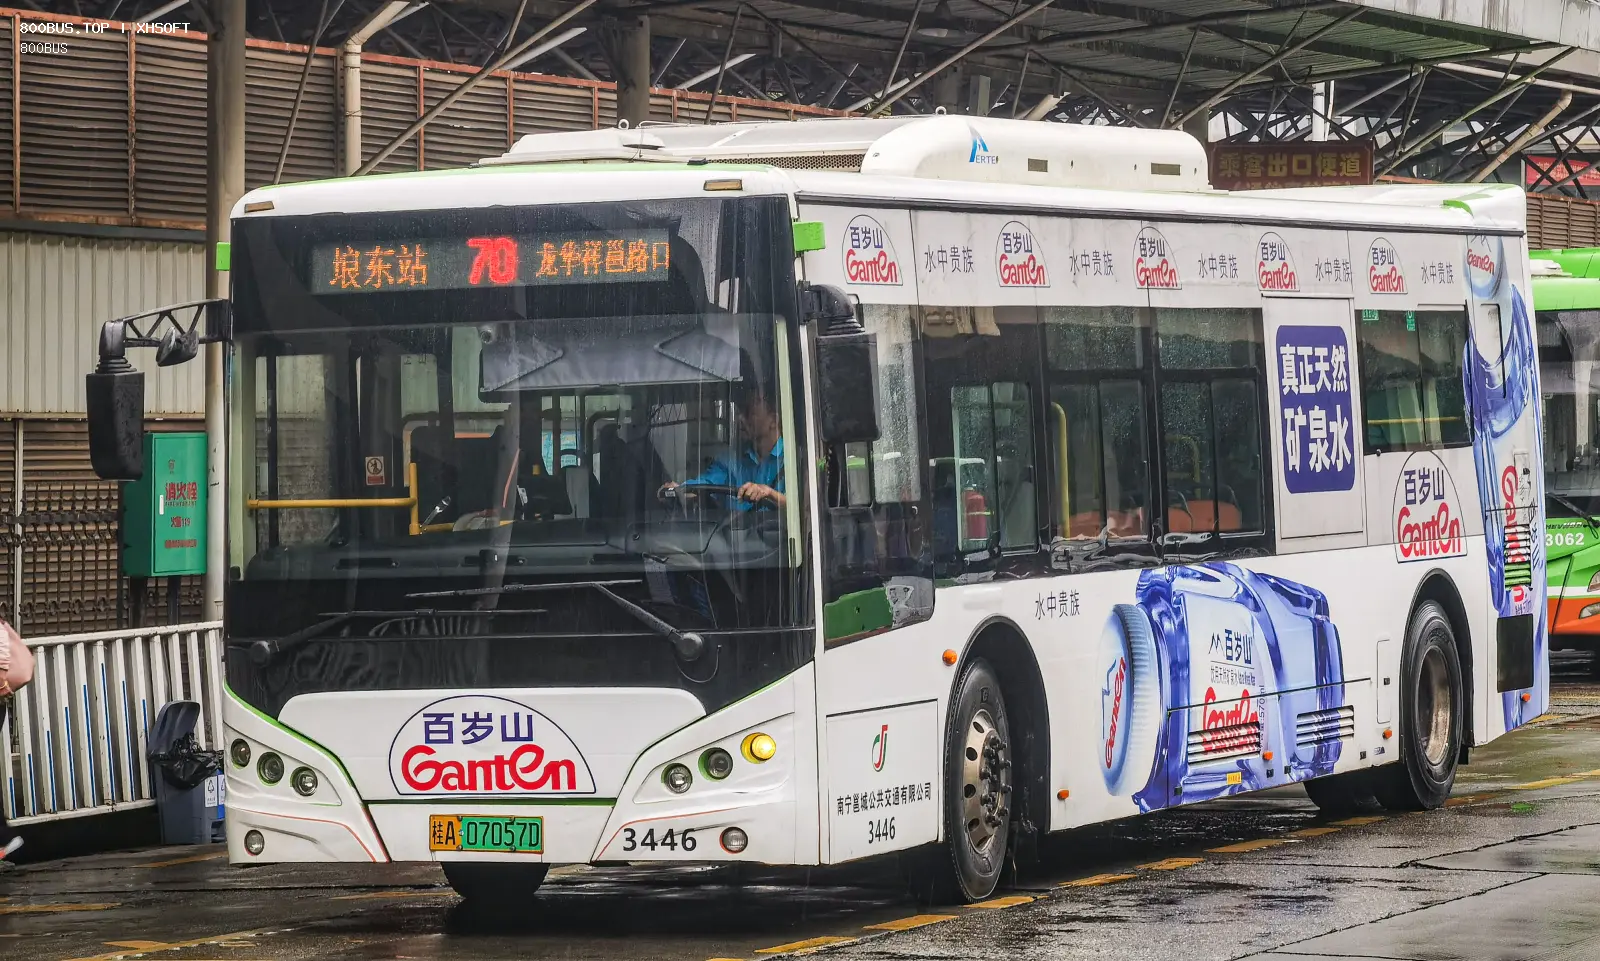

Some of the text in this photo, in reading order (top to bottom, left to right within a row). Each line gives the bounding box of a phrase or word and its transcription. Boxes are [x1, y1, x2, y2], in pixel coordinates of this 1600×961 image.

[1219, 152, 1361, 178] 乘客出口便道
[850, 226, 883, 249] 百岁山
[1002, 232, 1033, 254] 百岁山
[1138, 237, 1166, 258] 百岁山
[1261, 241, 1286, 261] 百岁山
[466, 236, 518, 286] 70
[846, 248, 898, 283] Ganten
[924, 245, 975, 273] 水中贵族
[1000, 253, 1046, 285] Ganten
[1069, 249, 1114, 276] 水中贵族
[1198, 253, 1239, 279] 水中贵族
[1315, 257, 1351, 283] 水中贵族
[1371, 247, 1395, 266] 百岁山
[1136, 257, 1178, 288] Ganten
[1258, 260, 1296, 290] Ganten
[1369, 265, 1405, 293] Ganten
[1420, 261, 1455, 285] 水中贵族
[1280, 343, 1348, 395] 真正天然
[1284, 404, 1351, 473] 矿泉水
[1403, 467, 1445, 505] 百岁山
[1398, 502, 1461, 558] Ganten
[1545, 532, 1585, 547] 3062
[1035, 588, 1080, 620] 水中贵族
[1224, 628, 1252, 664] 百岁山
[422, 711, 534, 745] 百岁山
[401, 743, 577, 791] Ganten
[837, 782, 931, 816] 南宁邕城公共交通有限公司
[622, 828, 697, 851] 3446
[868, 816, 896, 844] 3446
